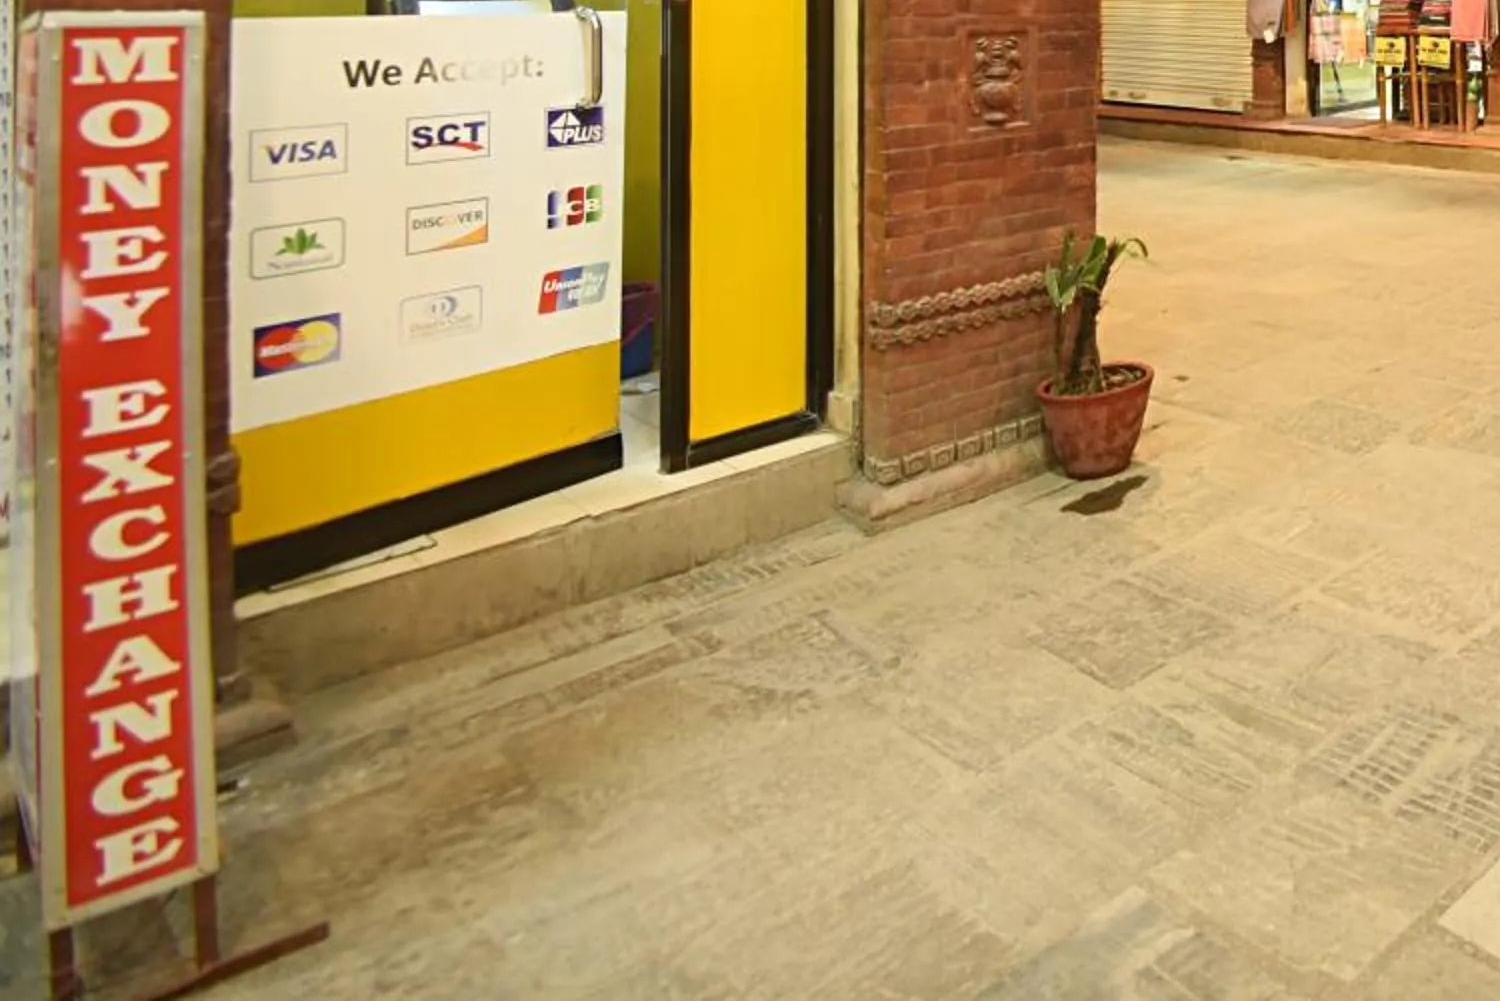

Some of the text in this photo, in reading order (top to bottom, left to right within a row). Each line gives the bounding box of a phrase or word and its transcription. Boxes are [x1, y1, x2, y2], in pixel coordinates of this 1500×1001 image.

[342, 59, 402, 88] We
[411, 120, 487, 150] SCT
[562, 125, 603, 144] PLUS
[265, 140, 337, 165] VISA
[72, 36, 179, 341] MONEY
[82, 379, 185, 889] EXCHANGE
